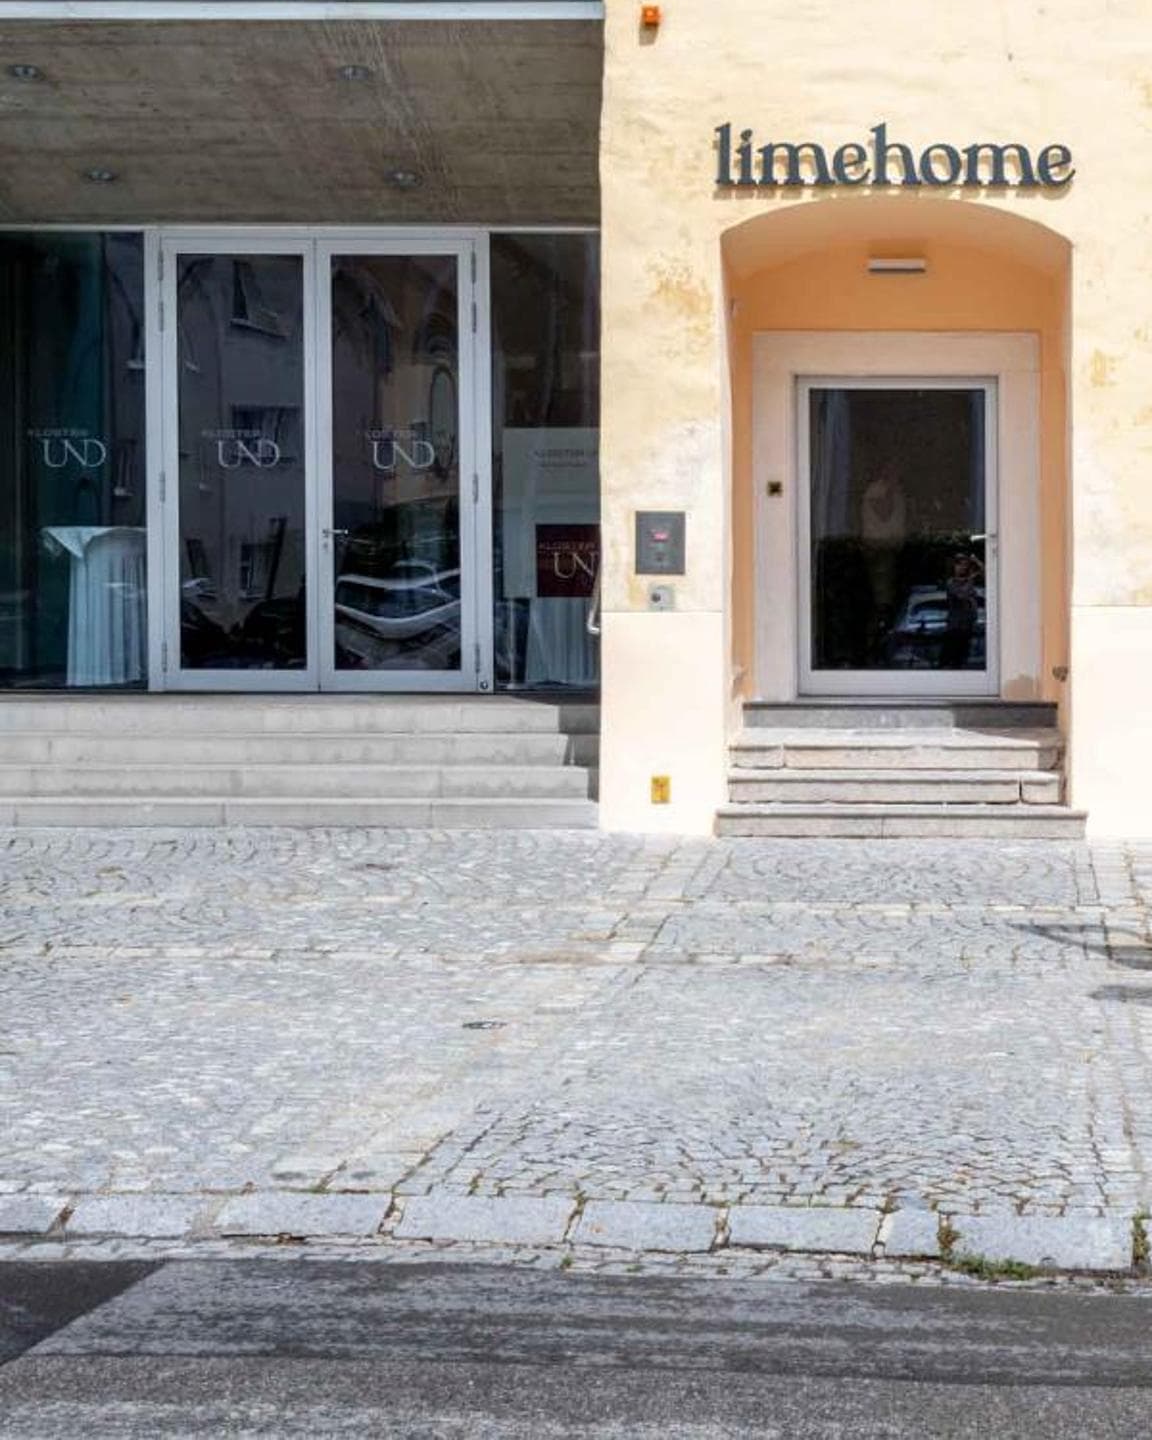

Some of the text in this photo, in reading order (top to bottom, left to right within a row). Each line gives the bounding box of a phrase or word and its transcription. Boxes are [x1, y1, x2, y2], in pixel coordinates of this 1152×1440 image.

[715, 122, 1076, 187] limehome
[43, 438, 107, 468] UND
[217, 439, 280, 468] UND
[370, 440, 436, 470] UND
[553, 550, 600, 580] UN
